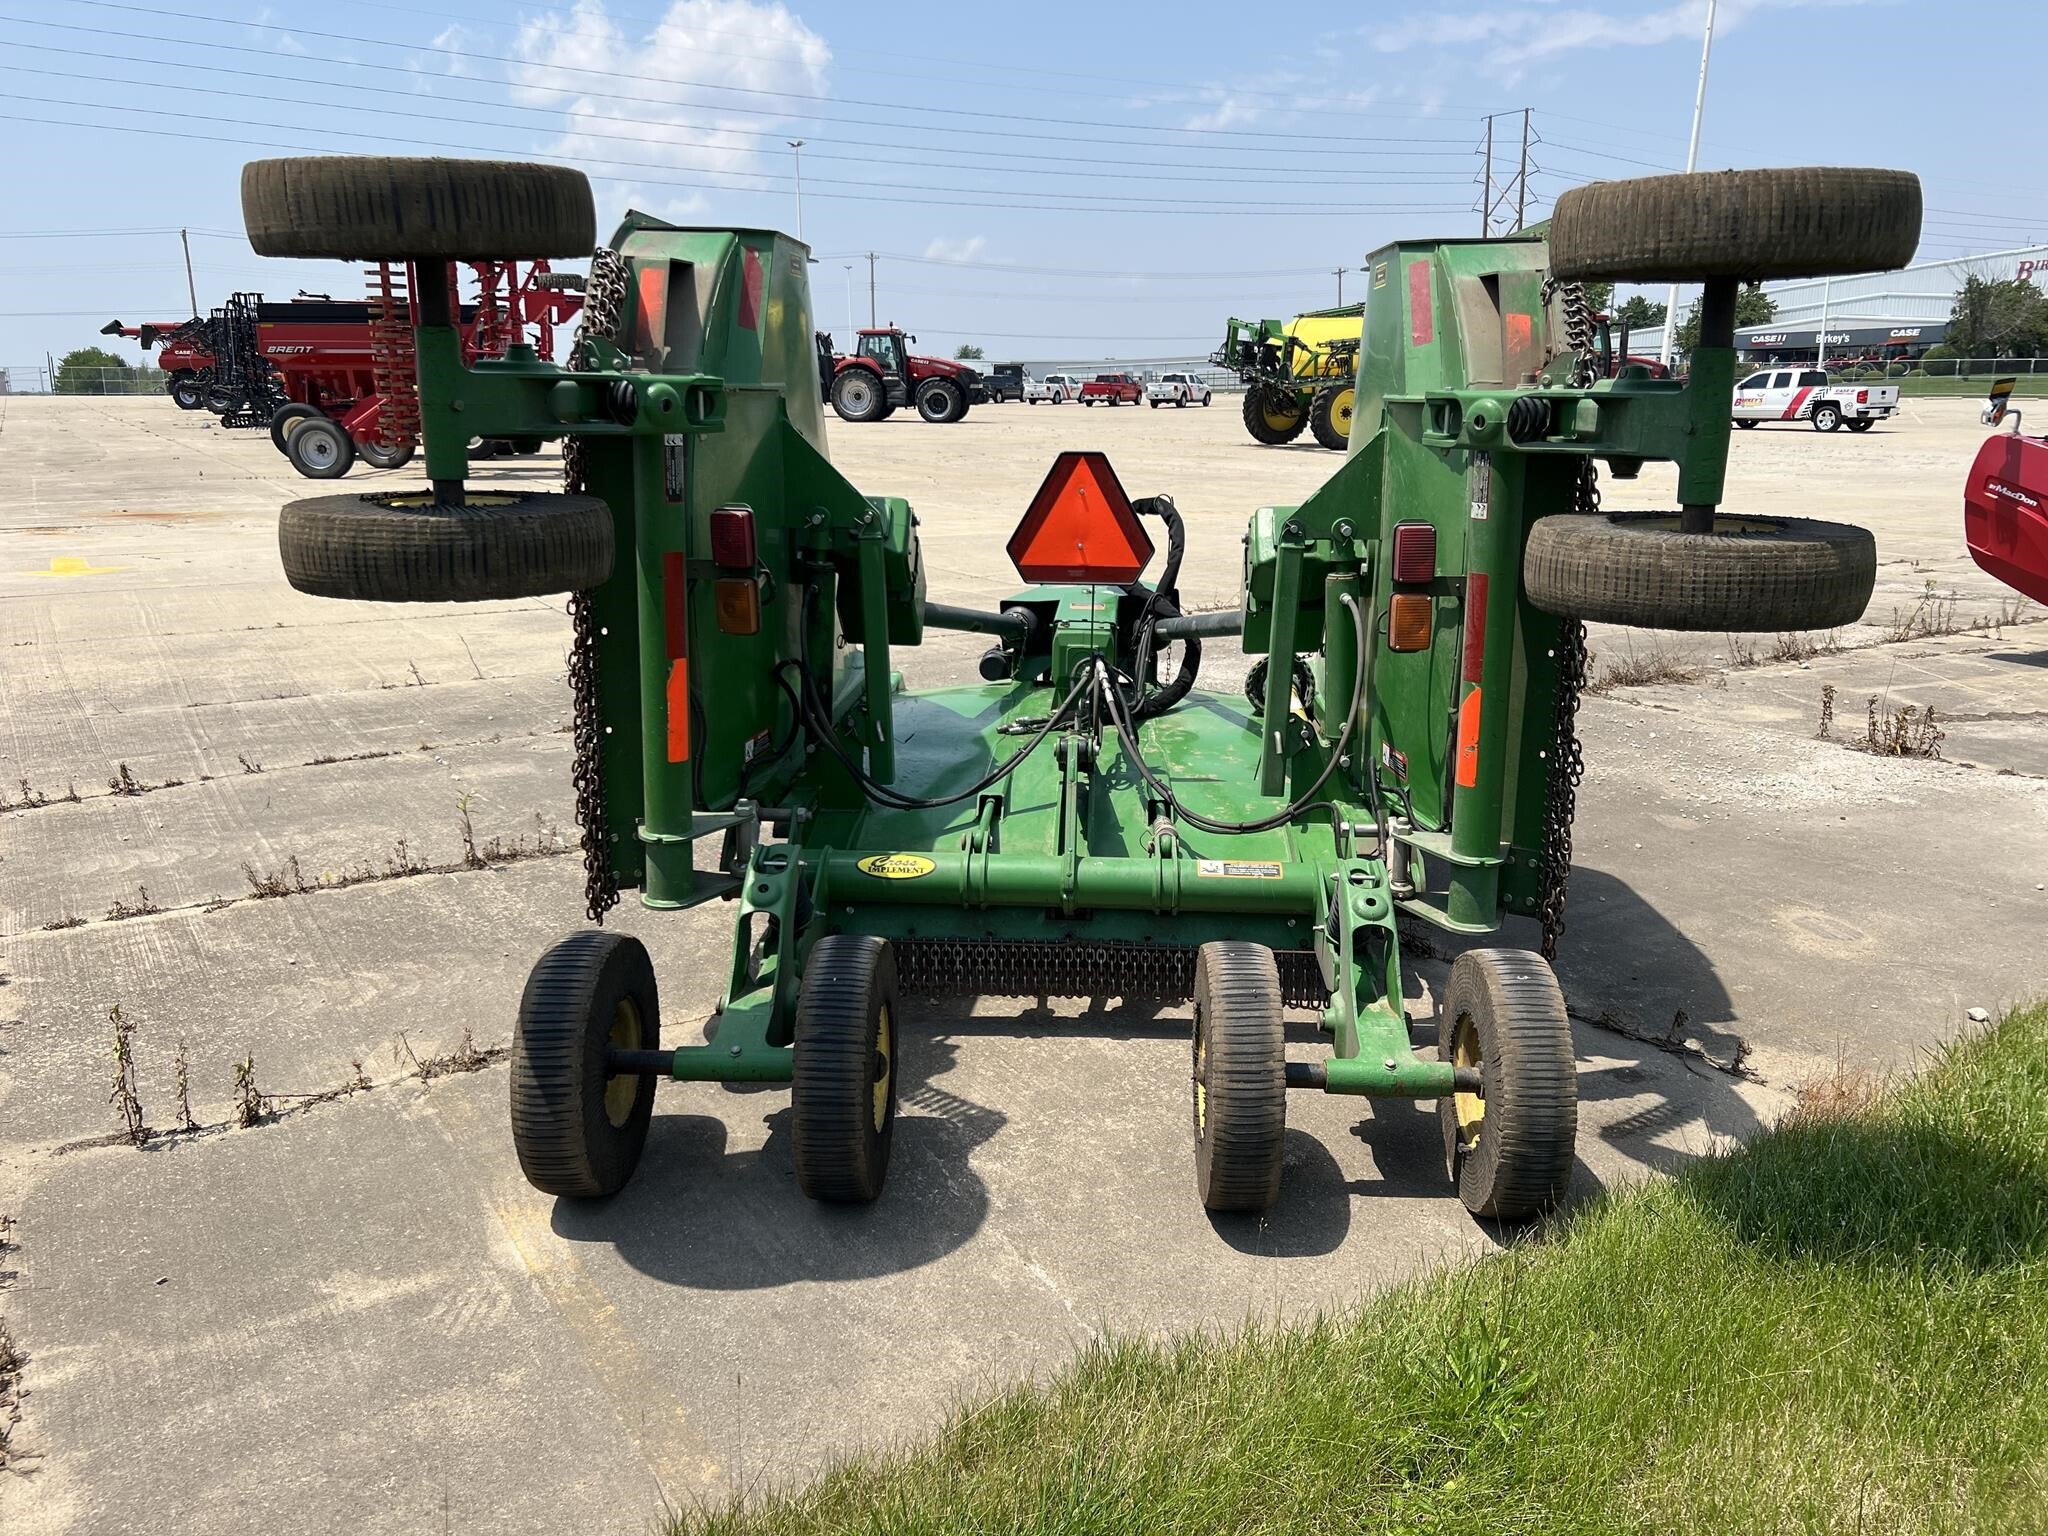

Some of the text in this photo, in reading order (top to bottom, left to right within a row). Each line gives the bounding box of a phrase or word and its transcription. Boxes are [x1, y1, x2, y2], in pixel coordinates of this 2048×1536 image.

[1891, 328, 1921, 337] CASE
[1751, 335, 1777, 343] CASE
[1815, 333, 1850, 345] Brkey's
[1995, 484, 2038, 507] MacDon
